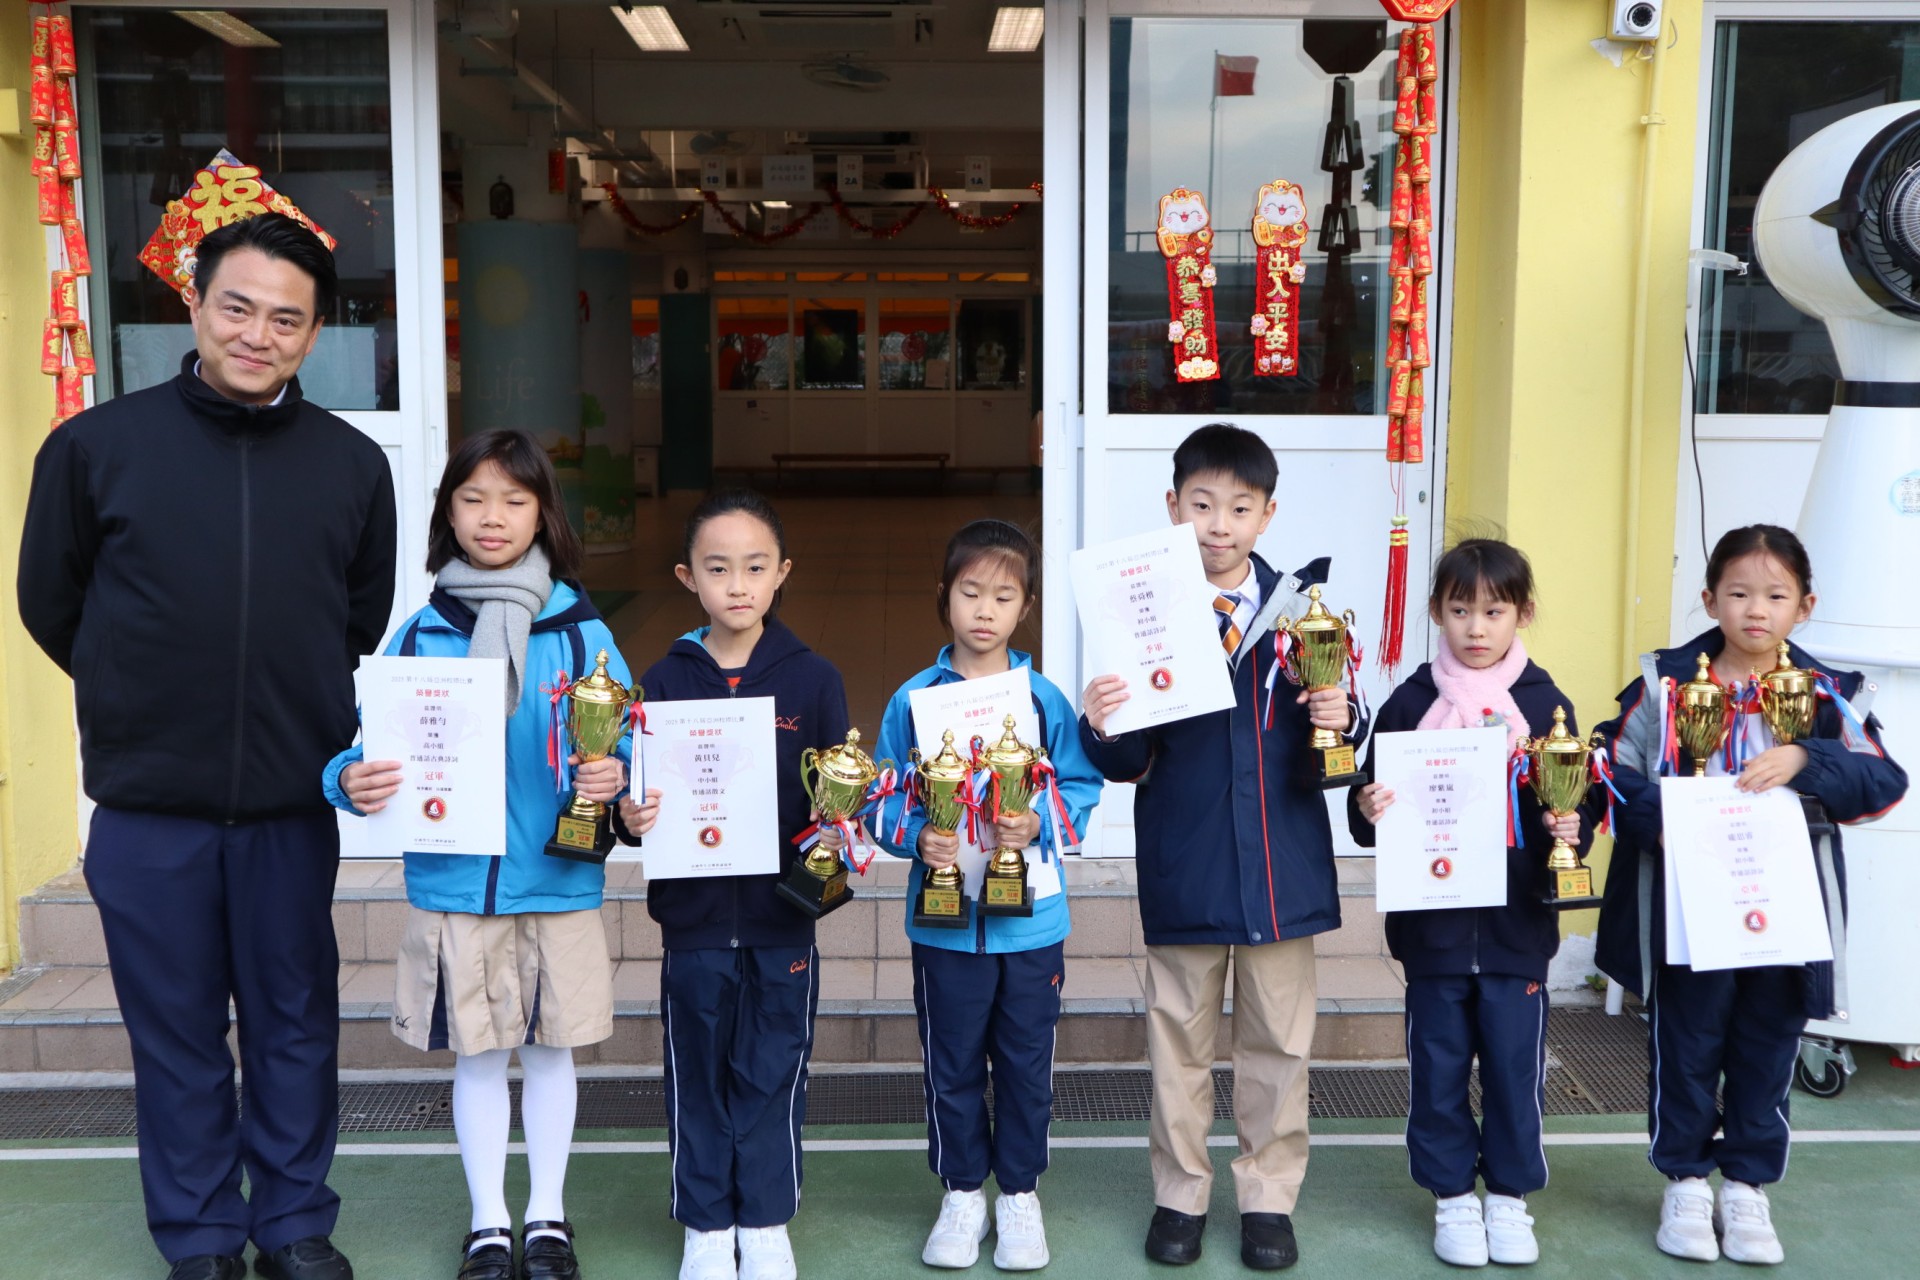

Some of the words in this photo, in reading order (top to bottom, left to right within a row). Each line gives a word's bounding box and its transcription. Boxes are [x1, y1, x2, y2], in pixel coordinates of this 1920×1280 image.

[844, 177, 858, 185] 2A
[970, 177, 983, 185] 1A
[191, 166, 268, 234] 福
[1266, 250, 1290, 350] 出入平安
[1176, 256, 1208, 355] 恭喜發財
[476, 358, 534, 415] Life
[1146, 642, 1164, 654] 季軍
[416, 688, 450, 698] 榮譽獎狀
[694, 754, 720, 762] 黃貝兒
[424, 772, 444, 780] 冠軍
[692, 788, 726, 796] 普通話散文
[700, 803, 719, 812] 冠軍
[1434, 834, 1450, 842] 季軍
